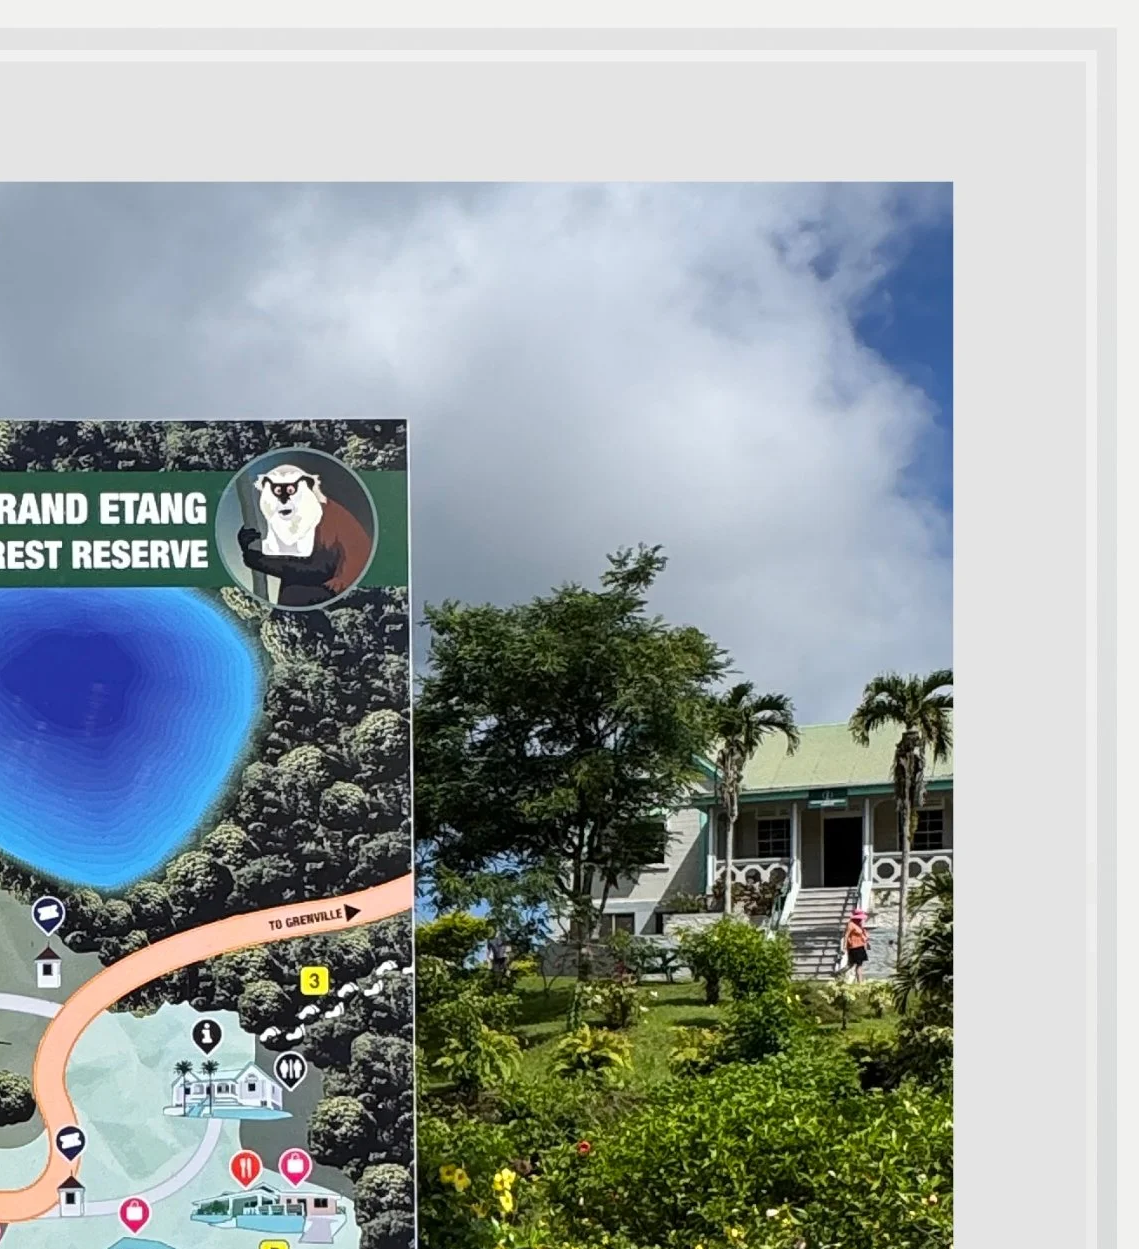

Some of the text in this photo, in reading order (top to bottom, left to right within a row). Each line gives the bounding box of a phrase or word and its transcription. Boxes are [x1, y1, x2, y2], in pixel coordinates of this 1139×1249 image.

[100, 492, 207, 524] ETANG
[72, 539, 209, 569] RESERVE
[268, 908, 343, 931] TO GRENVILLE
[309, 973, 320, 989] 3
